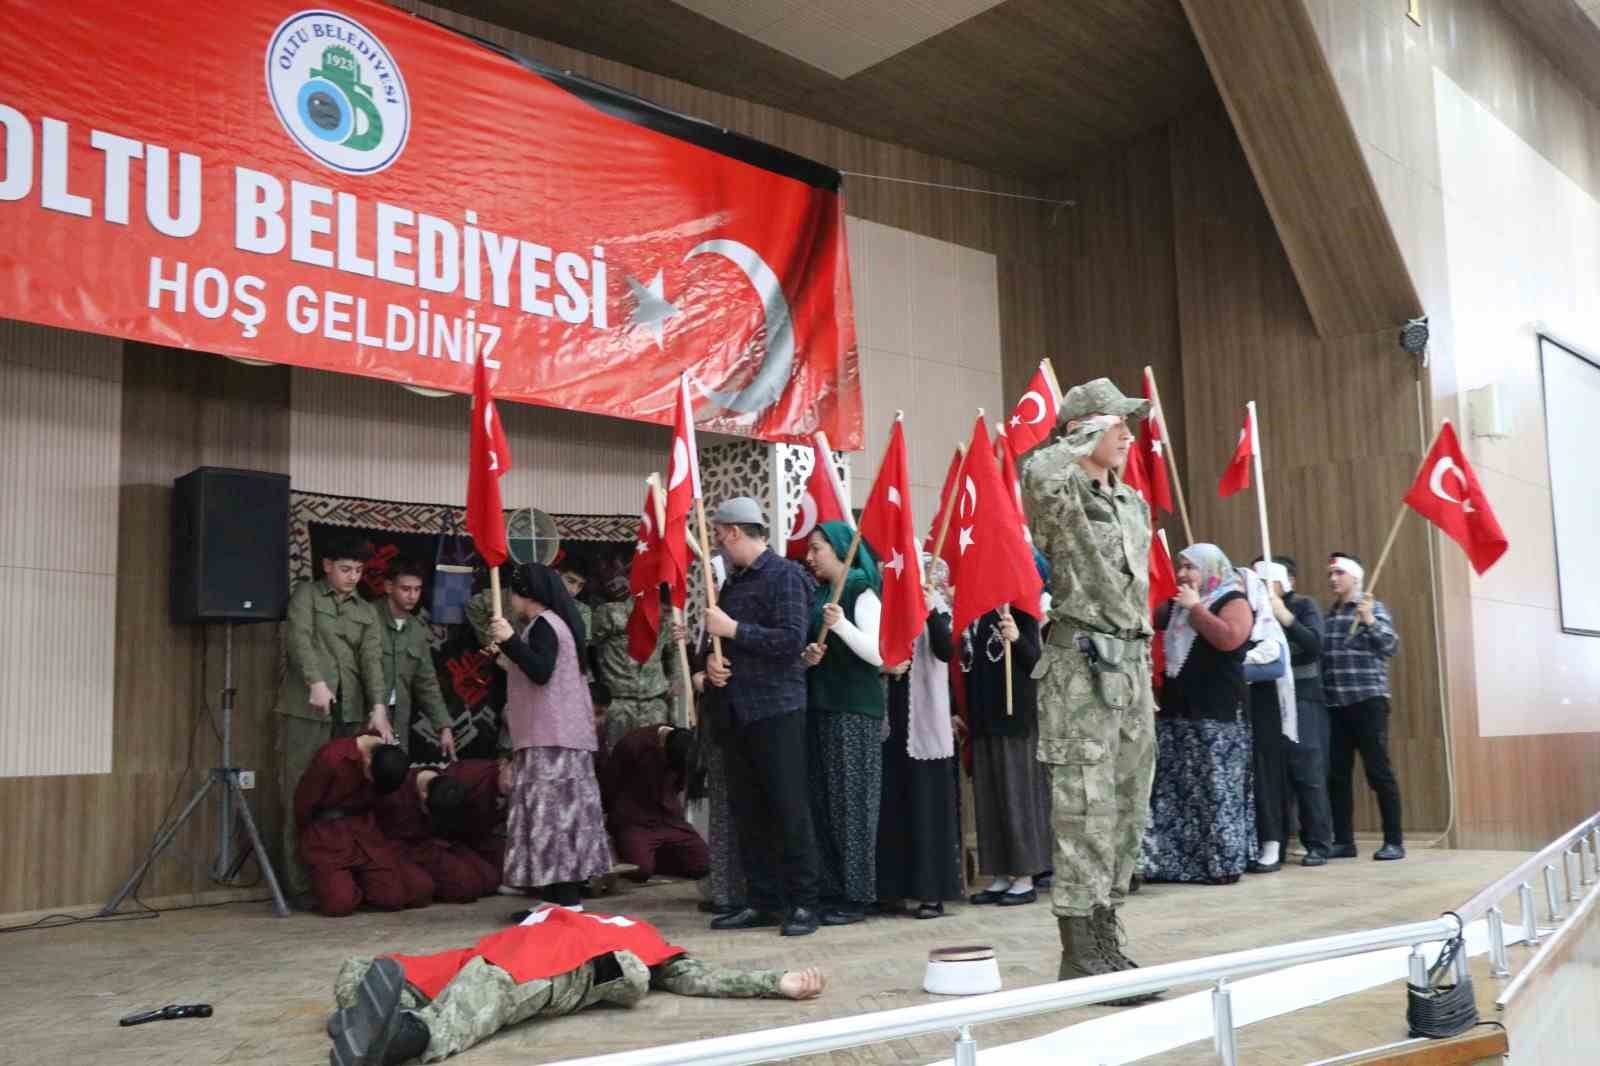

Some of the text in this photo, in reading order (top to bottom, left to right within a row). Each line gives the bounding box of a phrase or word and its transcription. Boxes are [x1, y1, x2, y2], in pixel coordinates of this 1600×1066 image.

[279, 24, 399, 104] OLTU BELEDİYESİ
[235, 166, 608, 329] BELEDİYESİ
[148, 256, 502, 369] HOŞ GELDİNİZ
